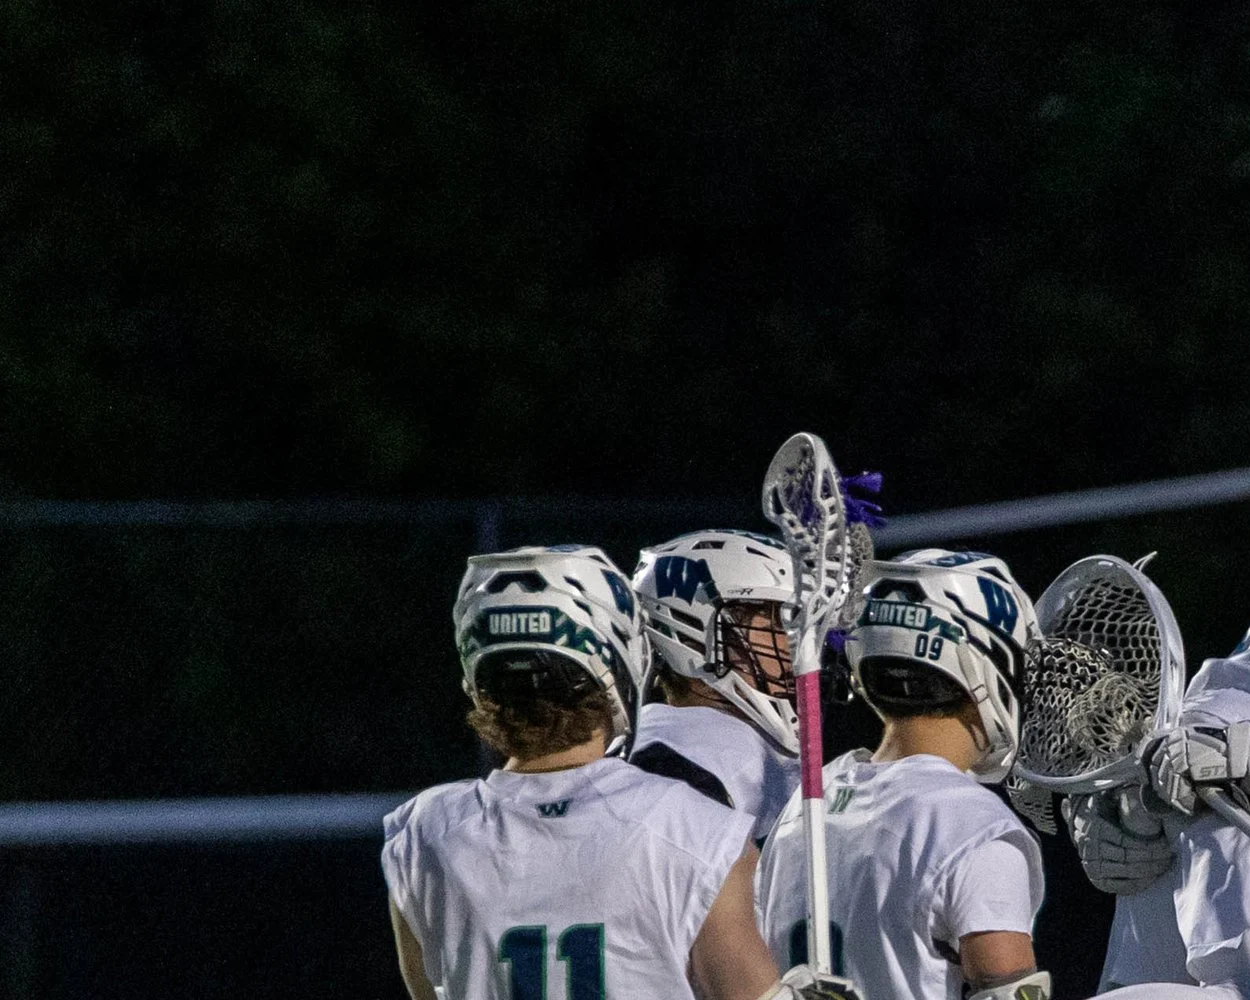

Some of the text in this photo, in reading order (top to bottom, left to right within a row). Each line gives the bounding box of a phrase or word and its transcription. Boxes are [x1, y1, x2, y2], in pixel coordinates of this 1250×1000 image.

[489, 611, 552, 634] UNITED
[869, 601, 929, 627] UNITED
[915, 633, 944, 661] 09
[536, 800, 571, 818] W
